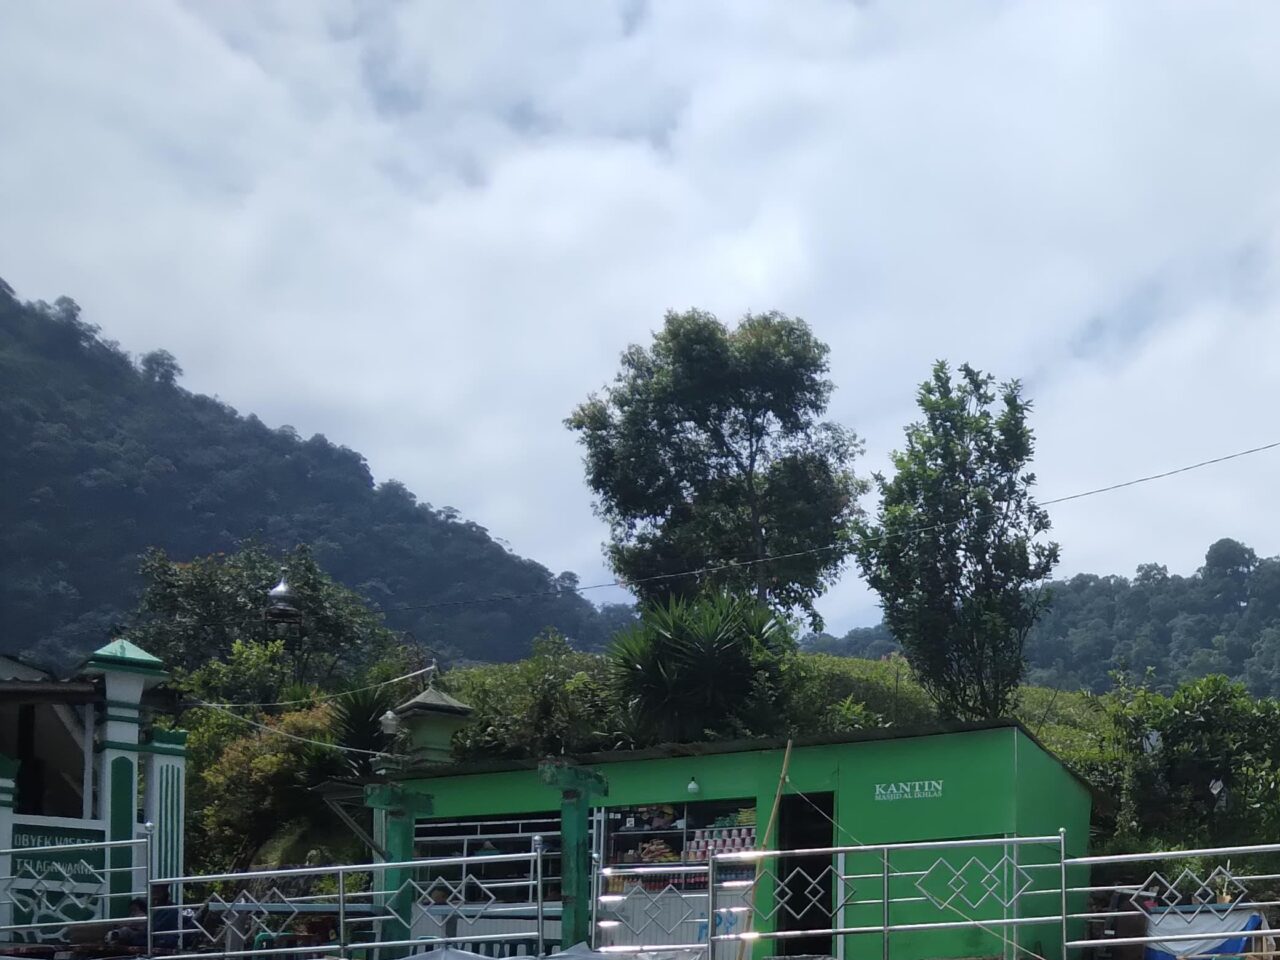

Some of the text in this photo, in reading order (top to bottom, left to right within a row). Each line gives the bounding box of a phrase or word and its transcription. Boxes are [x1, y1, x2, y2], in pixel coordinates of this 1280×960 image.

[874, 779, 944, 795] KANTIN
[874, 792, 902, 801] MASJID
[914, 790, 943, 799] IKHLAS
